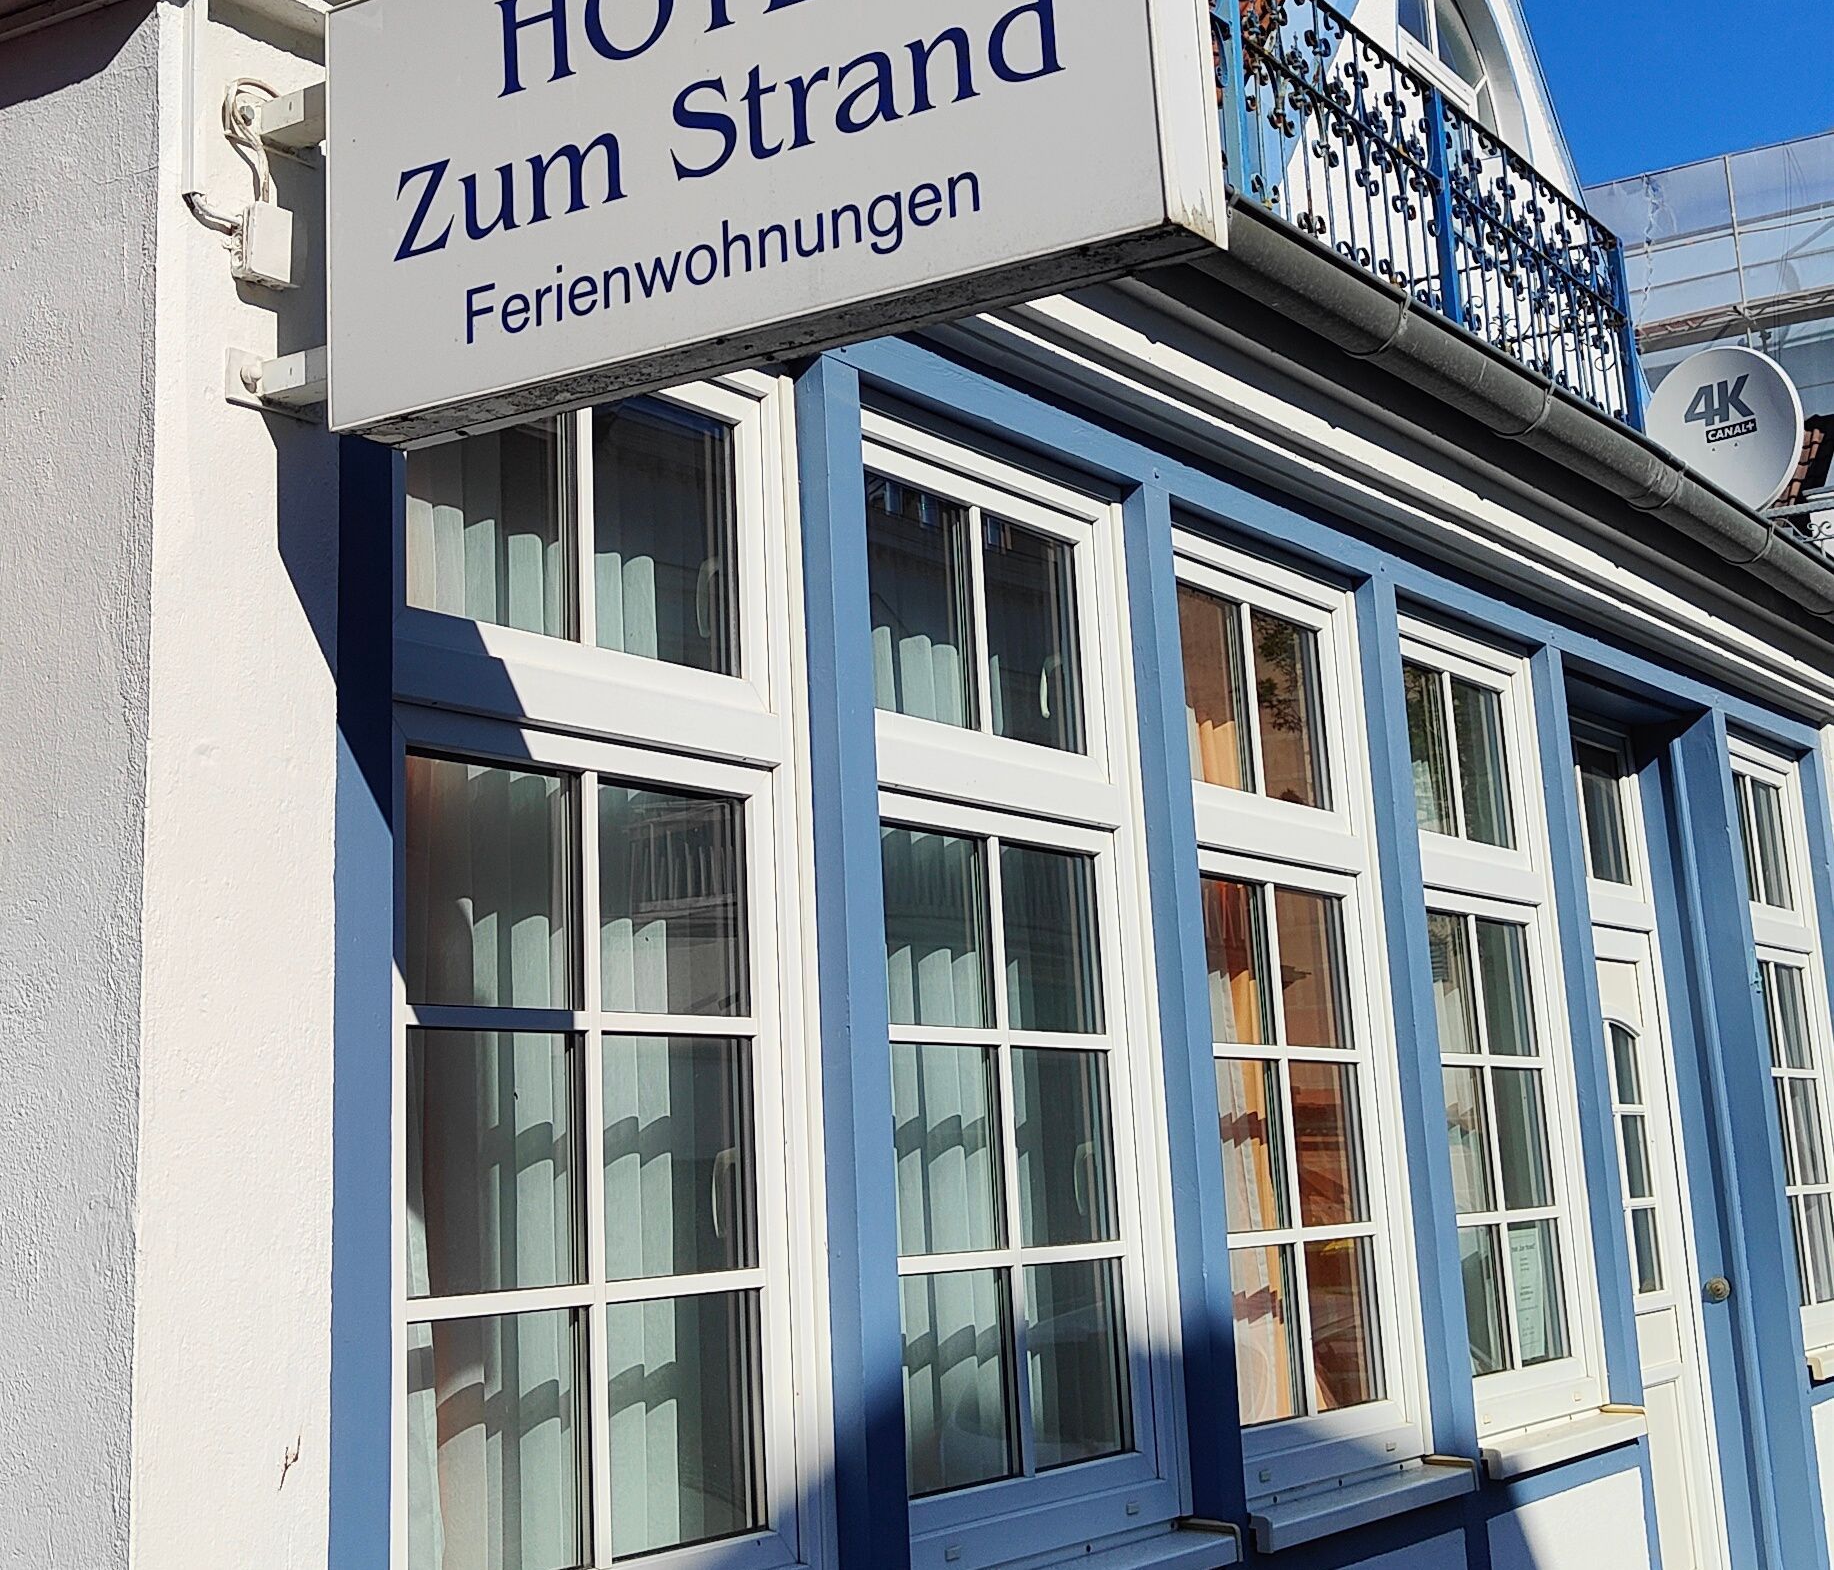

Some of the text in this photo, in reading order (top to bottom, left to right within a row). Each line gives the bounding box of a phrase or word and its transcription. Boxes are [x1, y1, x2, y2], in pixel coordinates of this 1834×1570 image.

[392, 131, 629, 264] Zum
[464, 170, 982, 346] Ferienwohnungen
[1683, 373, 1755, 427] 4K
[1707, 421, 1756, 442] CANAL+
